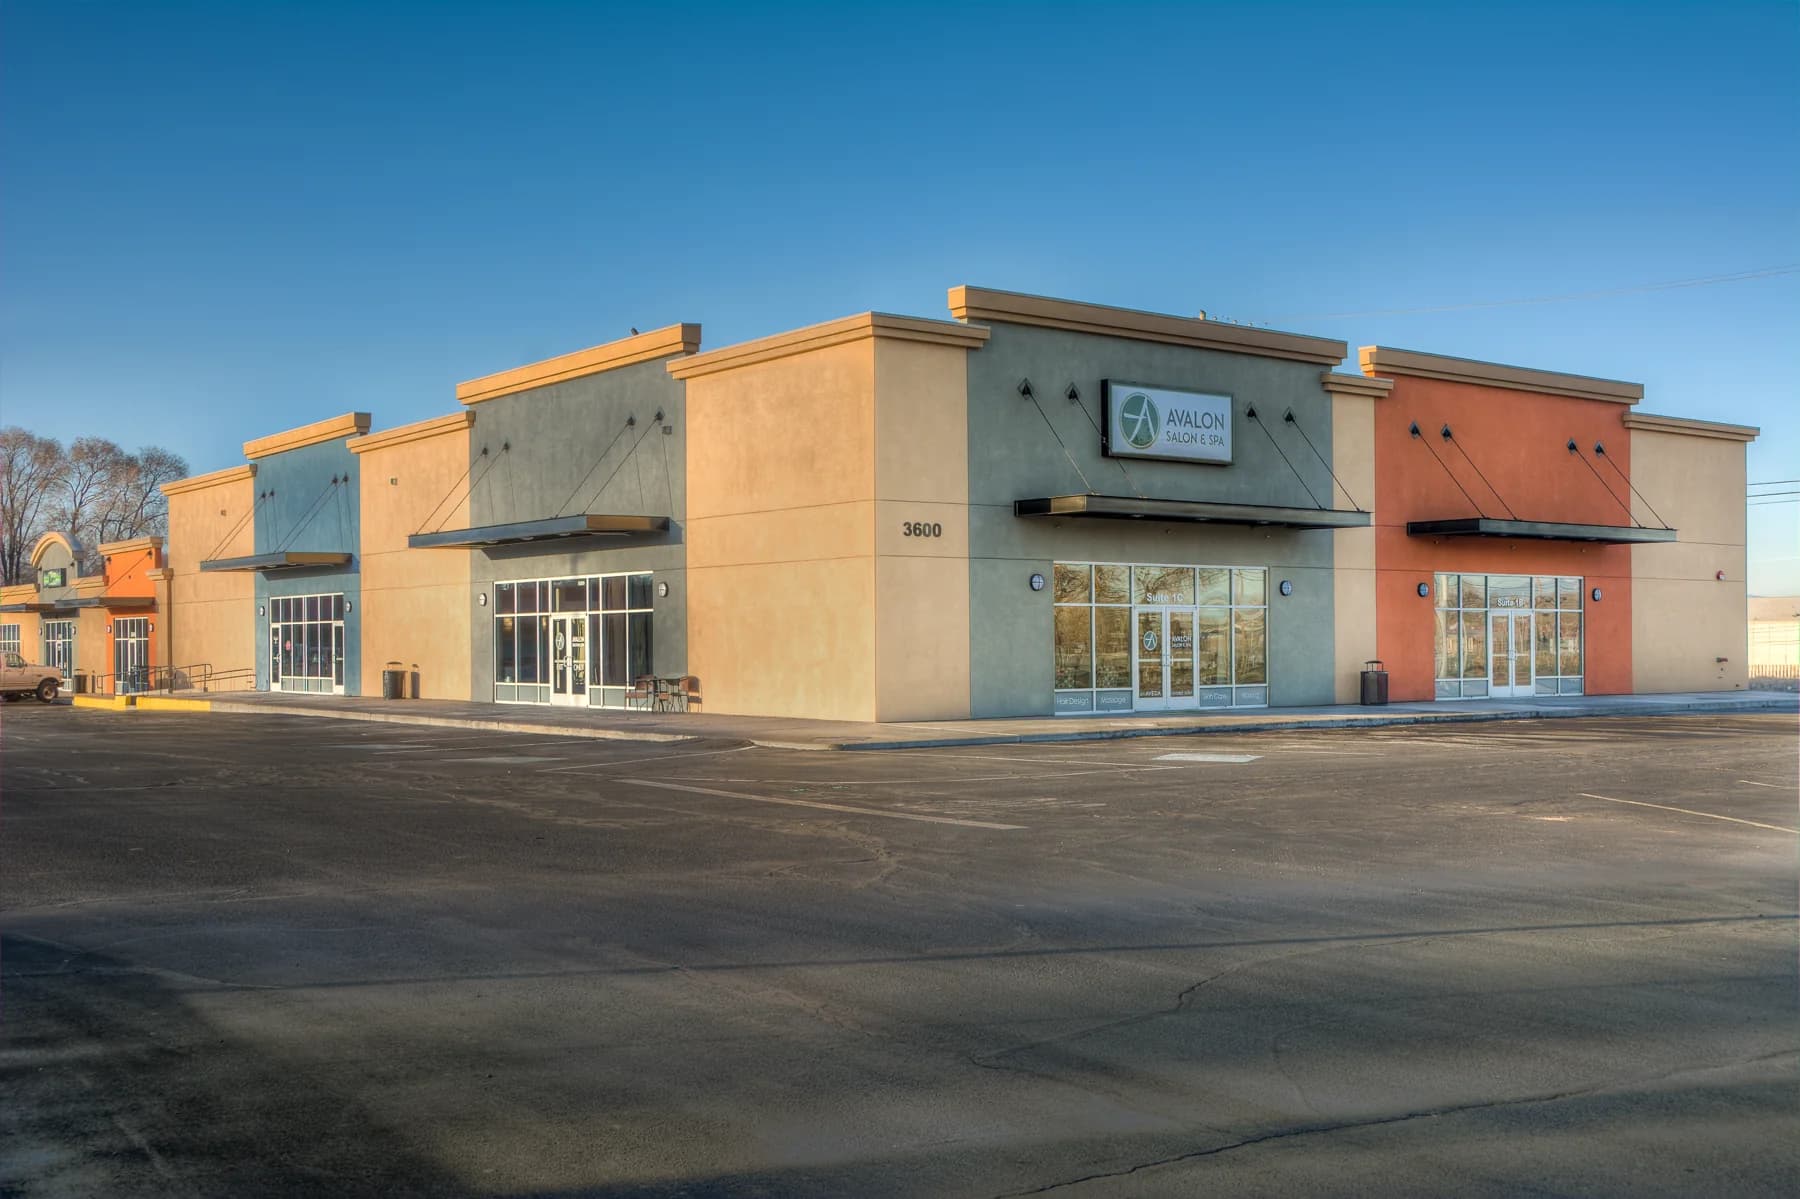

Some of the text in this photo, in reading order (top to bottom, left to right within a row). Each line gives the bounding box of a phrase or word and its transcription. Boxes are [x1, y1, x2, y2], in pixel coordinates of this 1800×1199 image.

[1166, 408, 1225, 430] AVALON
[1166, 430, 1225, 447] SALON & SPA
[903, 521, 942, 538] 3600
[1146, 592, 1169, 602] Suite
[1497, 598, 1514, 607] Suite
